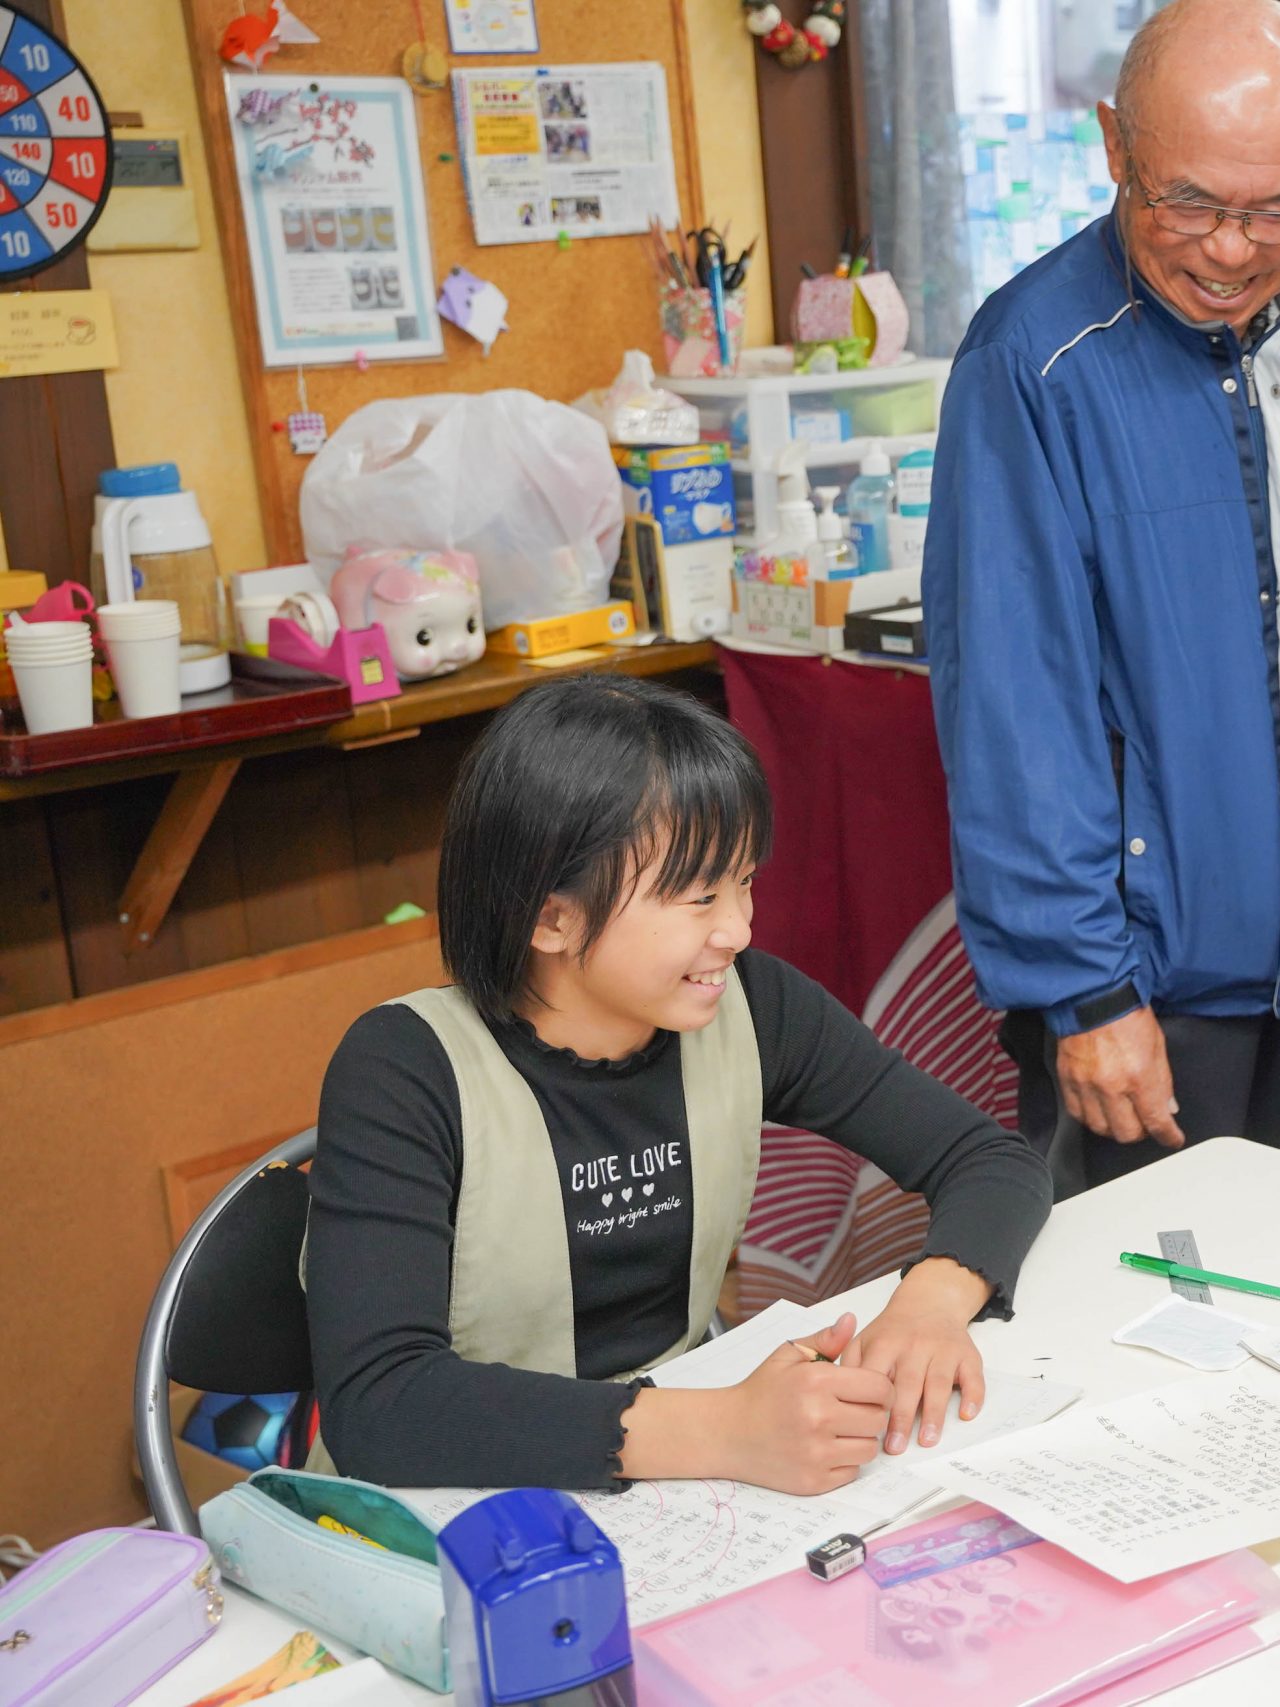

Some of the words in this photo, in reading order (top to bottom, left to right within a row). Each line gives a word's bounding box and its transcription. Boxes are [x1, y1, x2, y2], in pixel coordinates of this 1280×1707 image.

[20, 44, 50, 72] 10
[57, 95, 91, 122] 40
[10, 114, 38, 132] 110
[12, 142, 42, 160] 140
[66, 151, 96, 178] 10
[4, 168, 31, 186] 120
[45, 203, 78, 228] 50
[1, 230, 31, 257] 10
[571, 1155, 622, 1192] CUTE
[630, 1141, 682, 1178] LOVE
[576, 1216, 615, 1236] Happy
[617, 1207, 649, 1229] bright
[652, 1195, 682, 1216] smile
